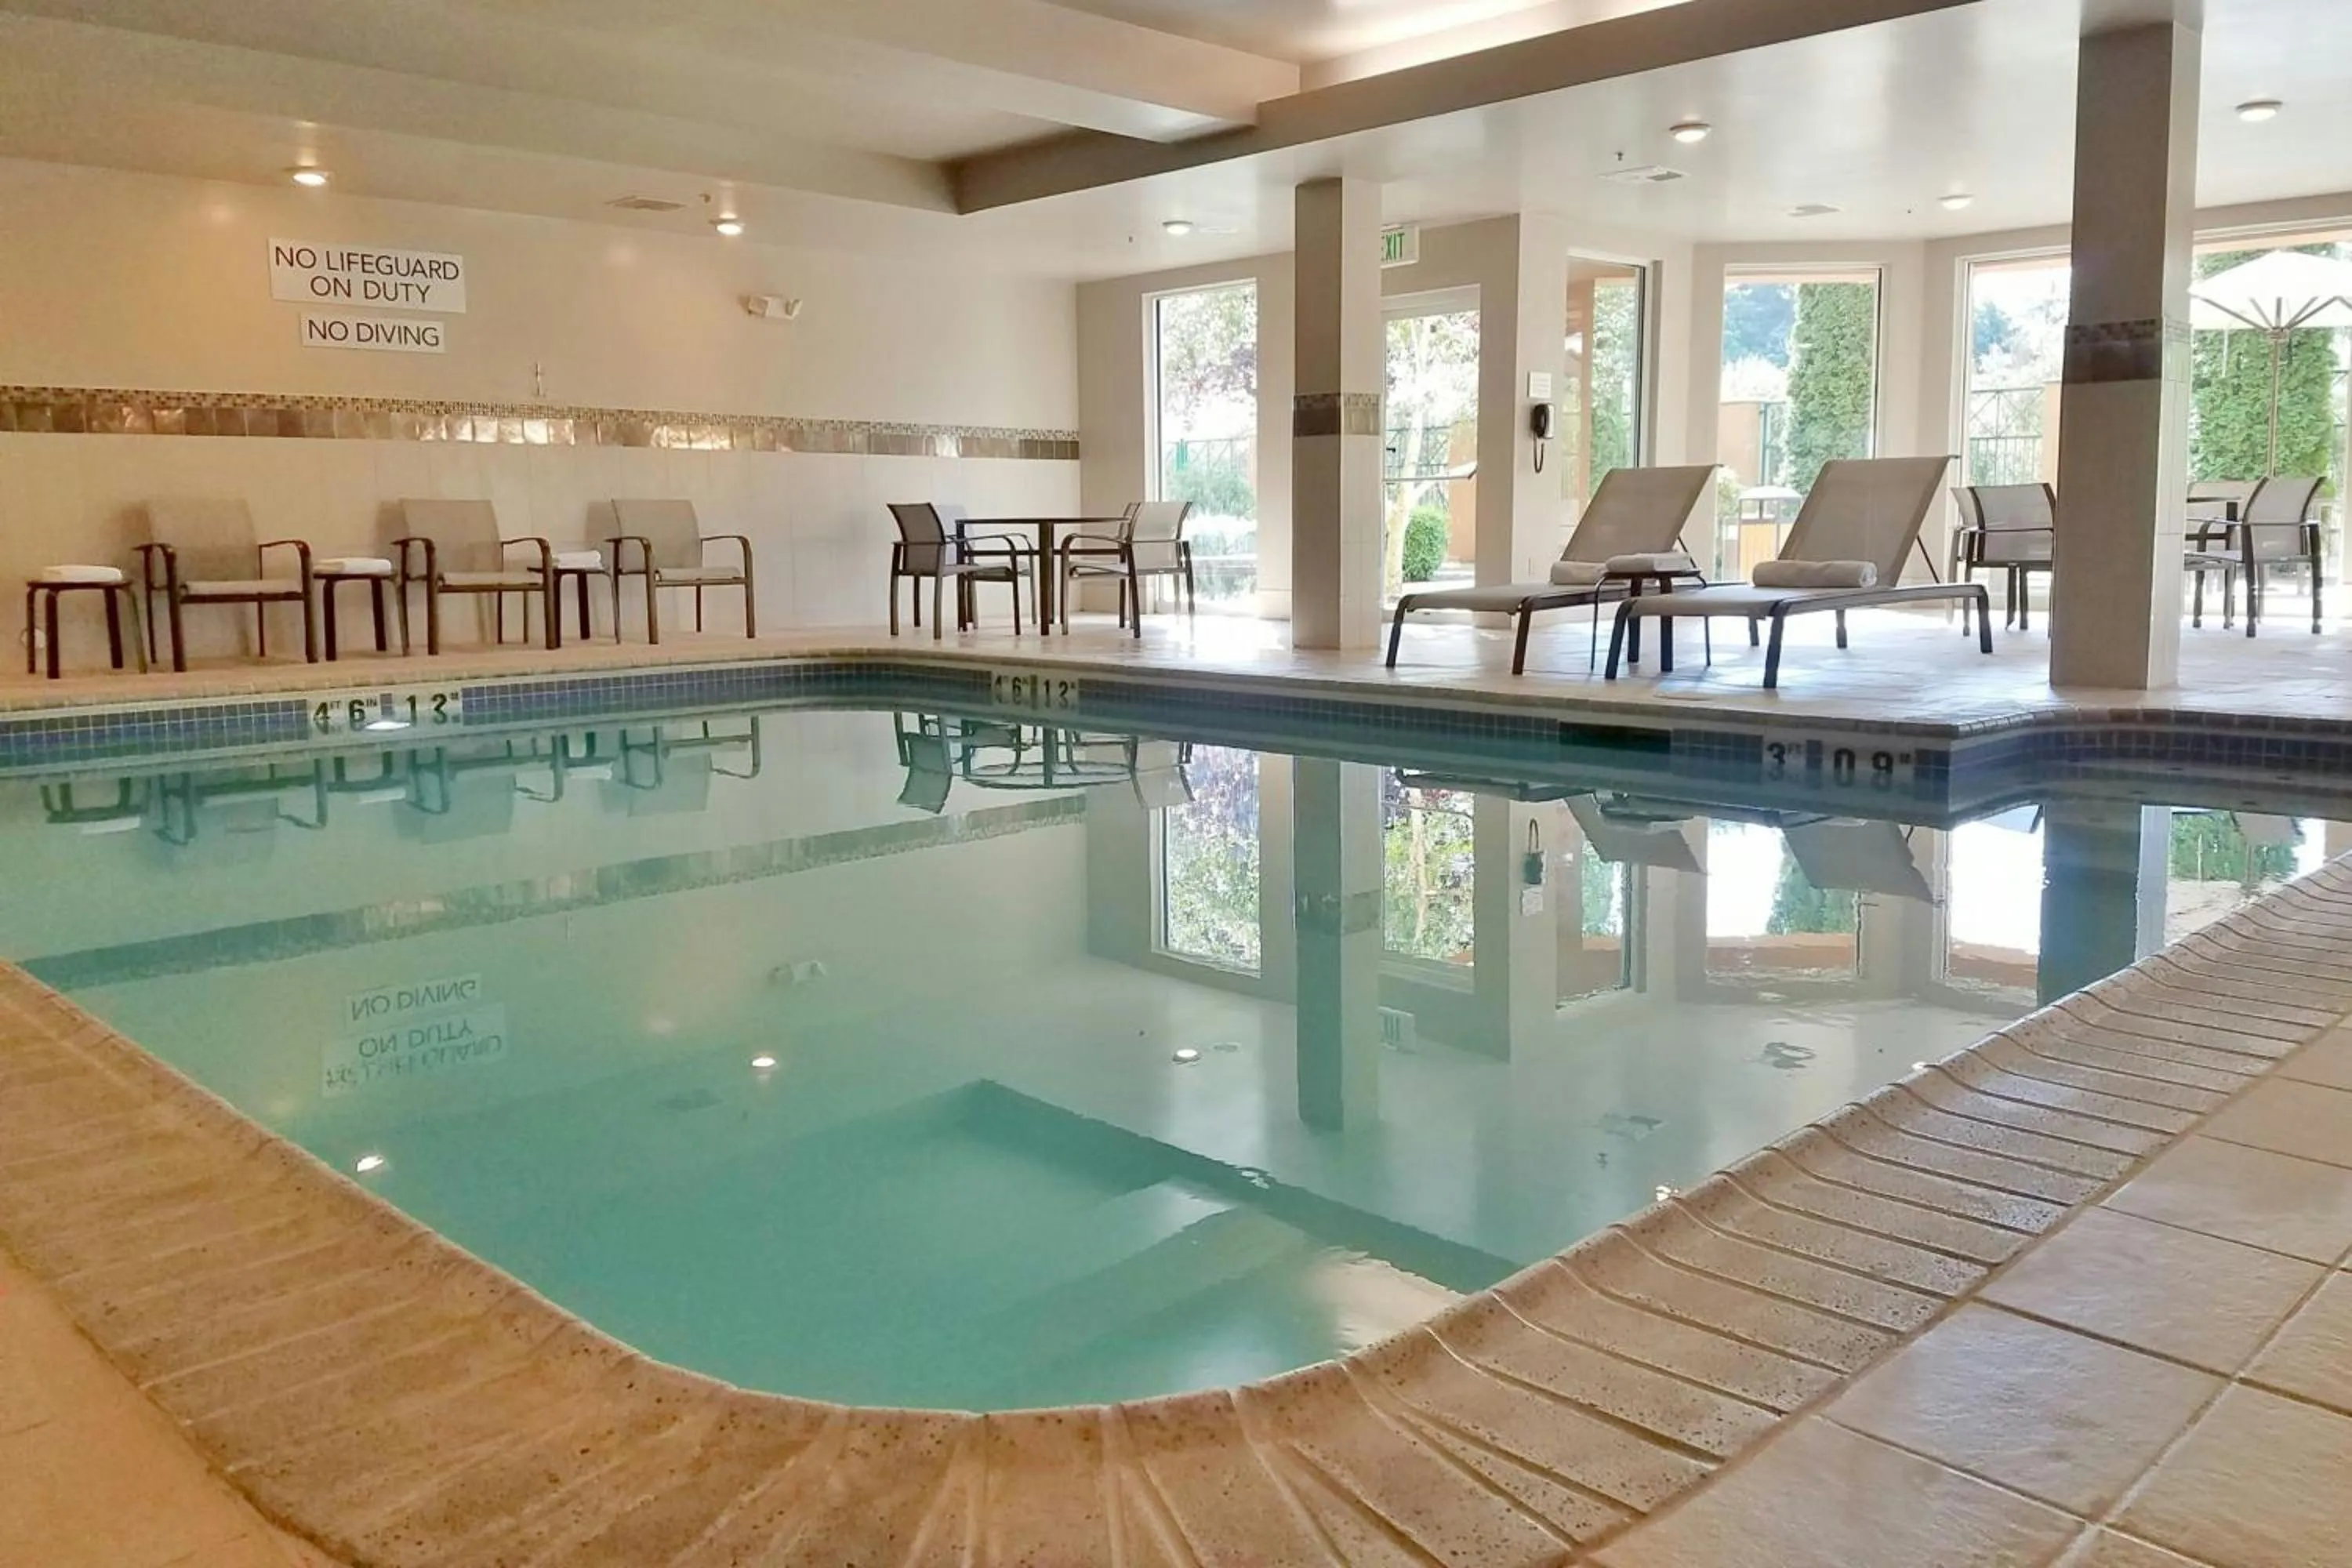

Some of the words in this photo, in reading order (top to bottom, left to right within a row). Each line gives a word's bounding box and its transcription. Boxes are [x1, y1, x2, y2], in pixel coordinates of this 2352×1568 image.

[1381, 232, 1405, 261] XIT
[275, 245, 317, 269] NO
[325, 250, 459, 281] LIFEGUARD
[310, 275, 352, 299] ON
[364, 279, 430, 303] DUTY
[308, 319, 349, 342] NO
[356, 321, 440, 347] DIVING
